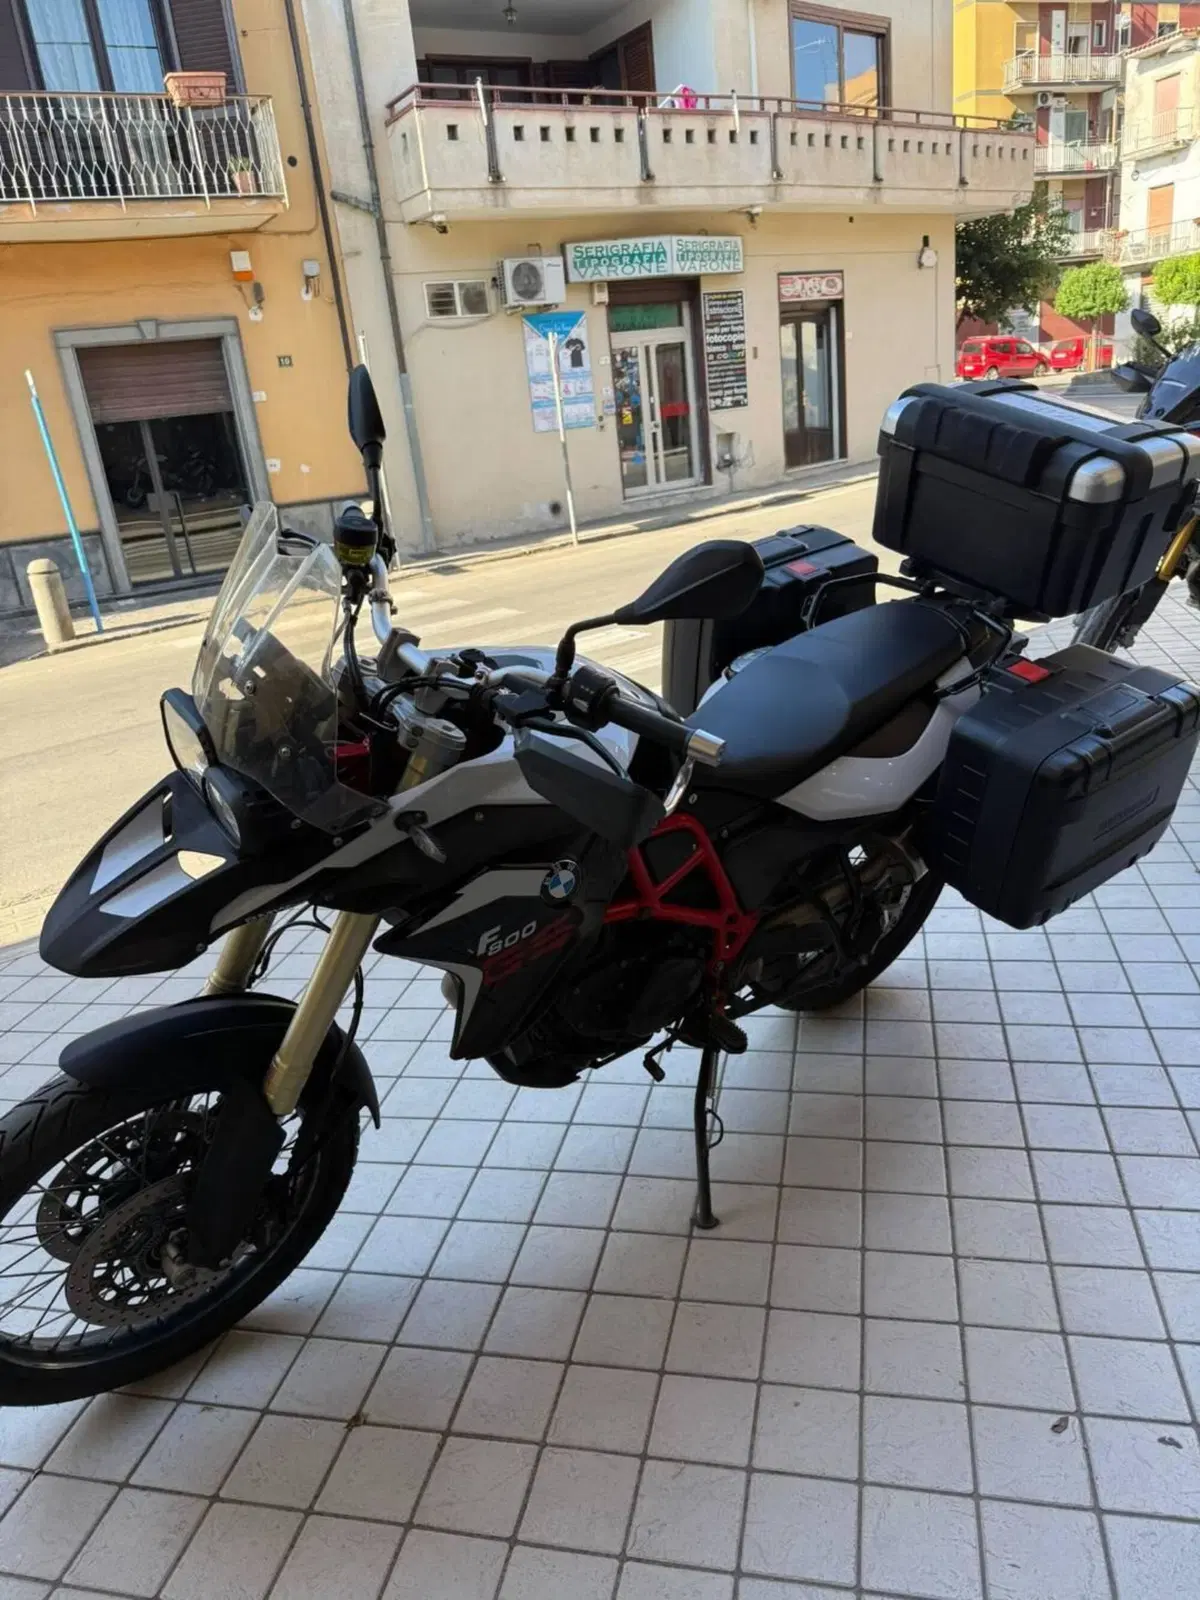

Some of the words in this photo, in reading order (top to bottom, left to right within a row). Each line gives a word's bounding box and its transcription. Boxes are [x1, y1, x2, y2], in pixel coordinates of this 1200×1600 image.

[573, 241, 666, 258] SERIGRAFIA
[676, 239, 739, 251] SERIGRAFIA
[574, 254, 667, 268] TIPOGRAFIA
[677, 250, 740, 261] TIPOGRAFIA
[574, 264, 668, 279] VARONE
[676, 260, 741, 271] VARONE
